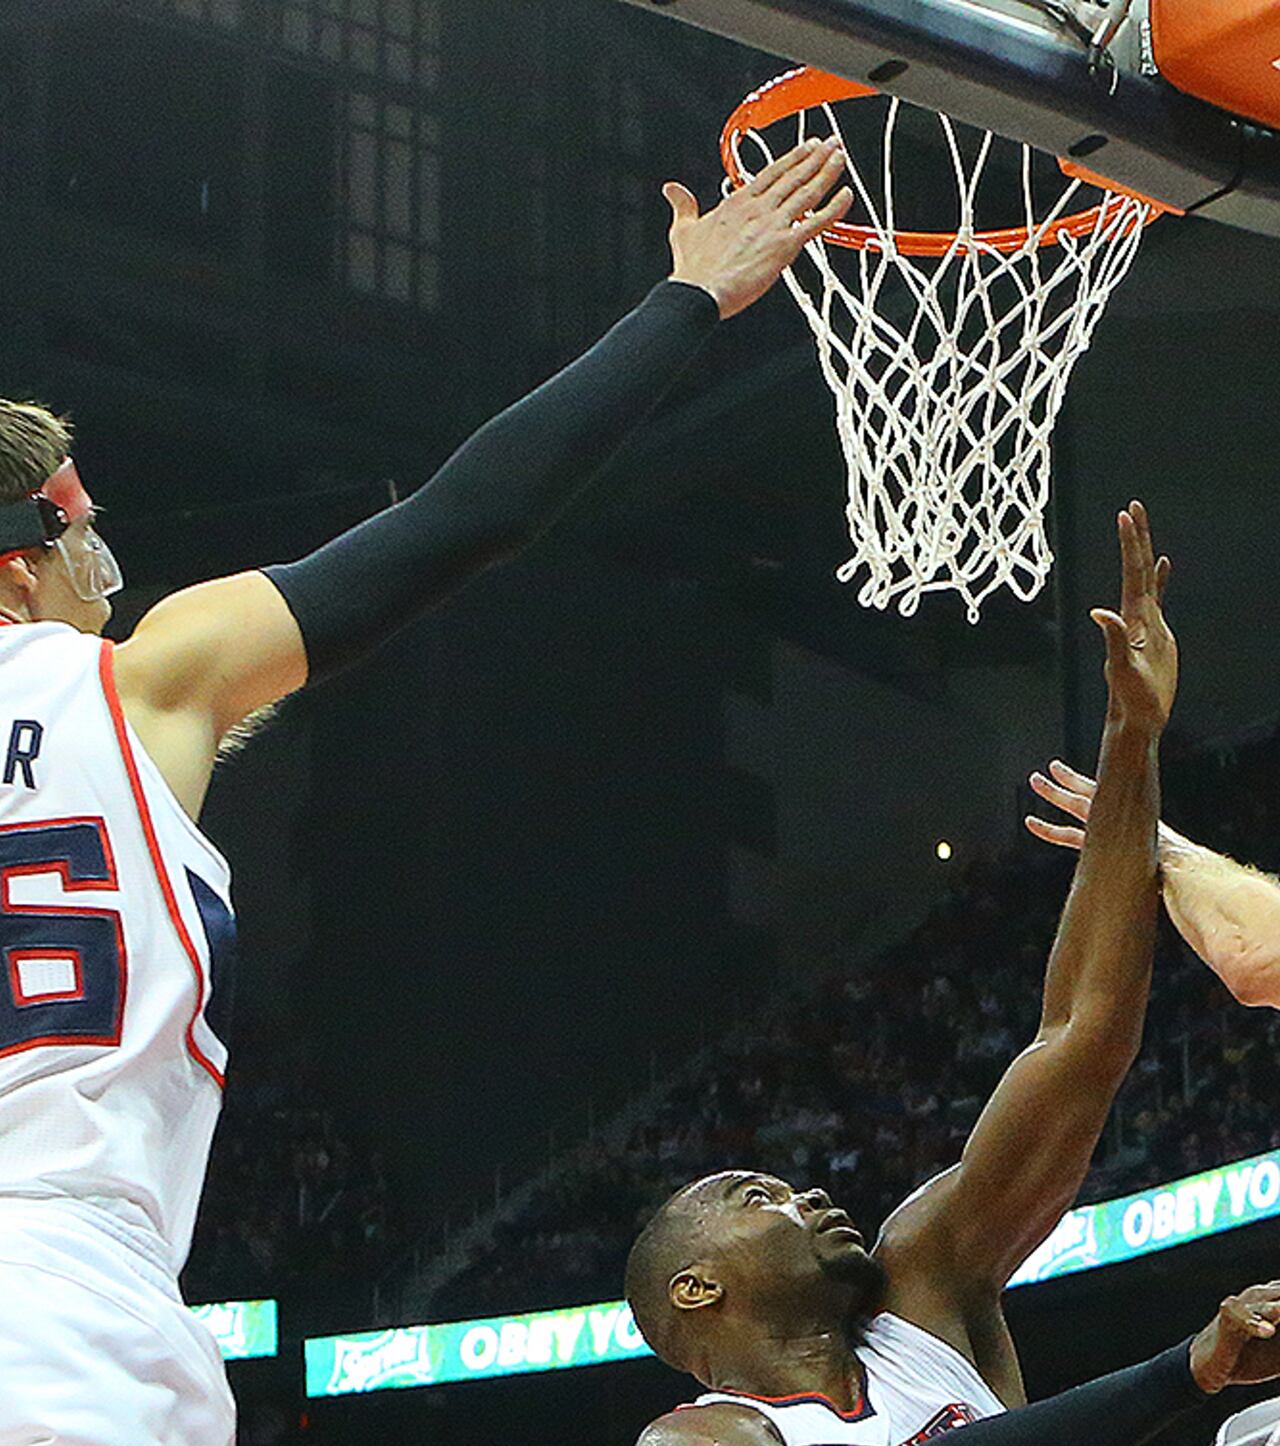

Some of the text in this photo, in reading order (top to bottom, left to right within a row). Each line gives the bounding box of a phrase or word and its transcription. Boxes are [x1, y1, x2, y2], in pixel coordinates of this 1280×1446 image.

[1122, 1173, 1225, 1248] OBEY
[459, 1306, 645, 1371] OBEY YO
